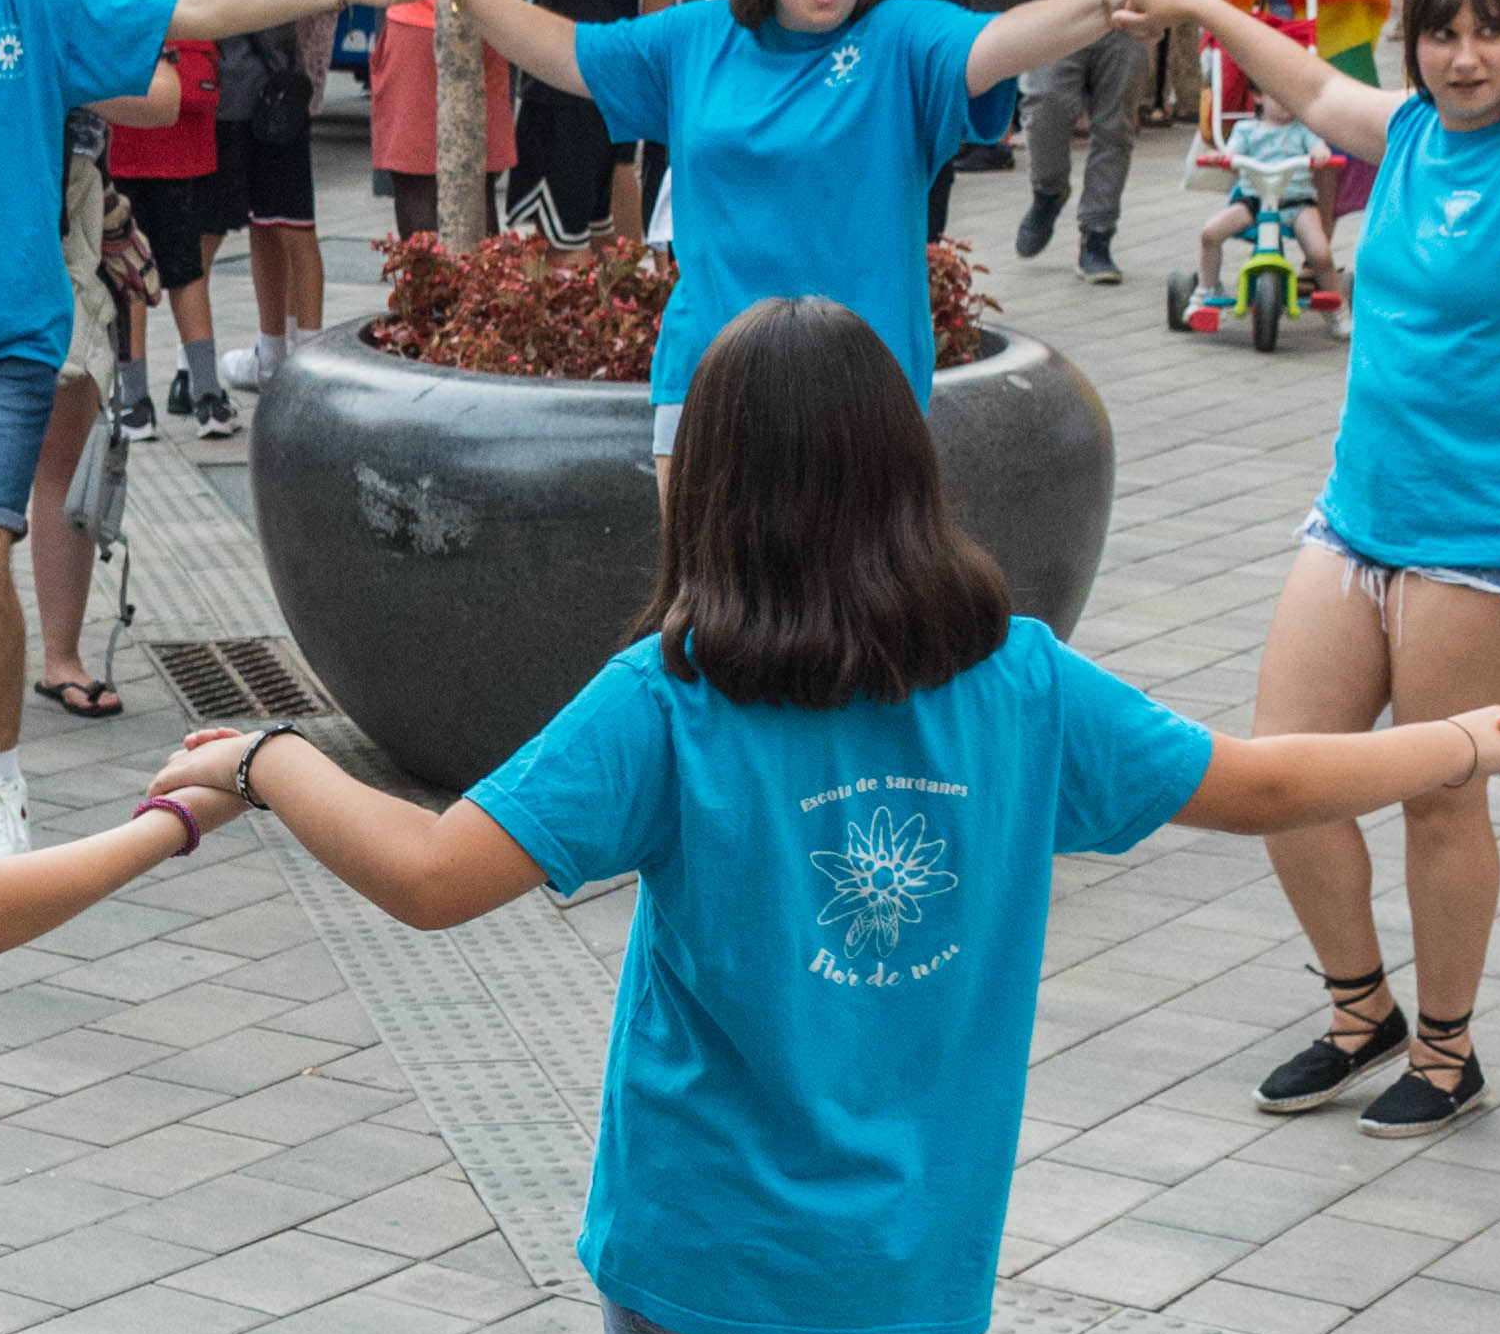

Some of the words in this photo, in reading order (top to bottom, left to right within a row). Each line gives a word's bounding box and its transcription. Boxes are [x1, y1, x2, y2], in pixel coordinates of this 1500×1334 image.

[799, 784, 853, 814] Escola
[855, 777, 878, 794] de
[865, 961, 904, 988] de
[910, 942, 961, 980] neu
